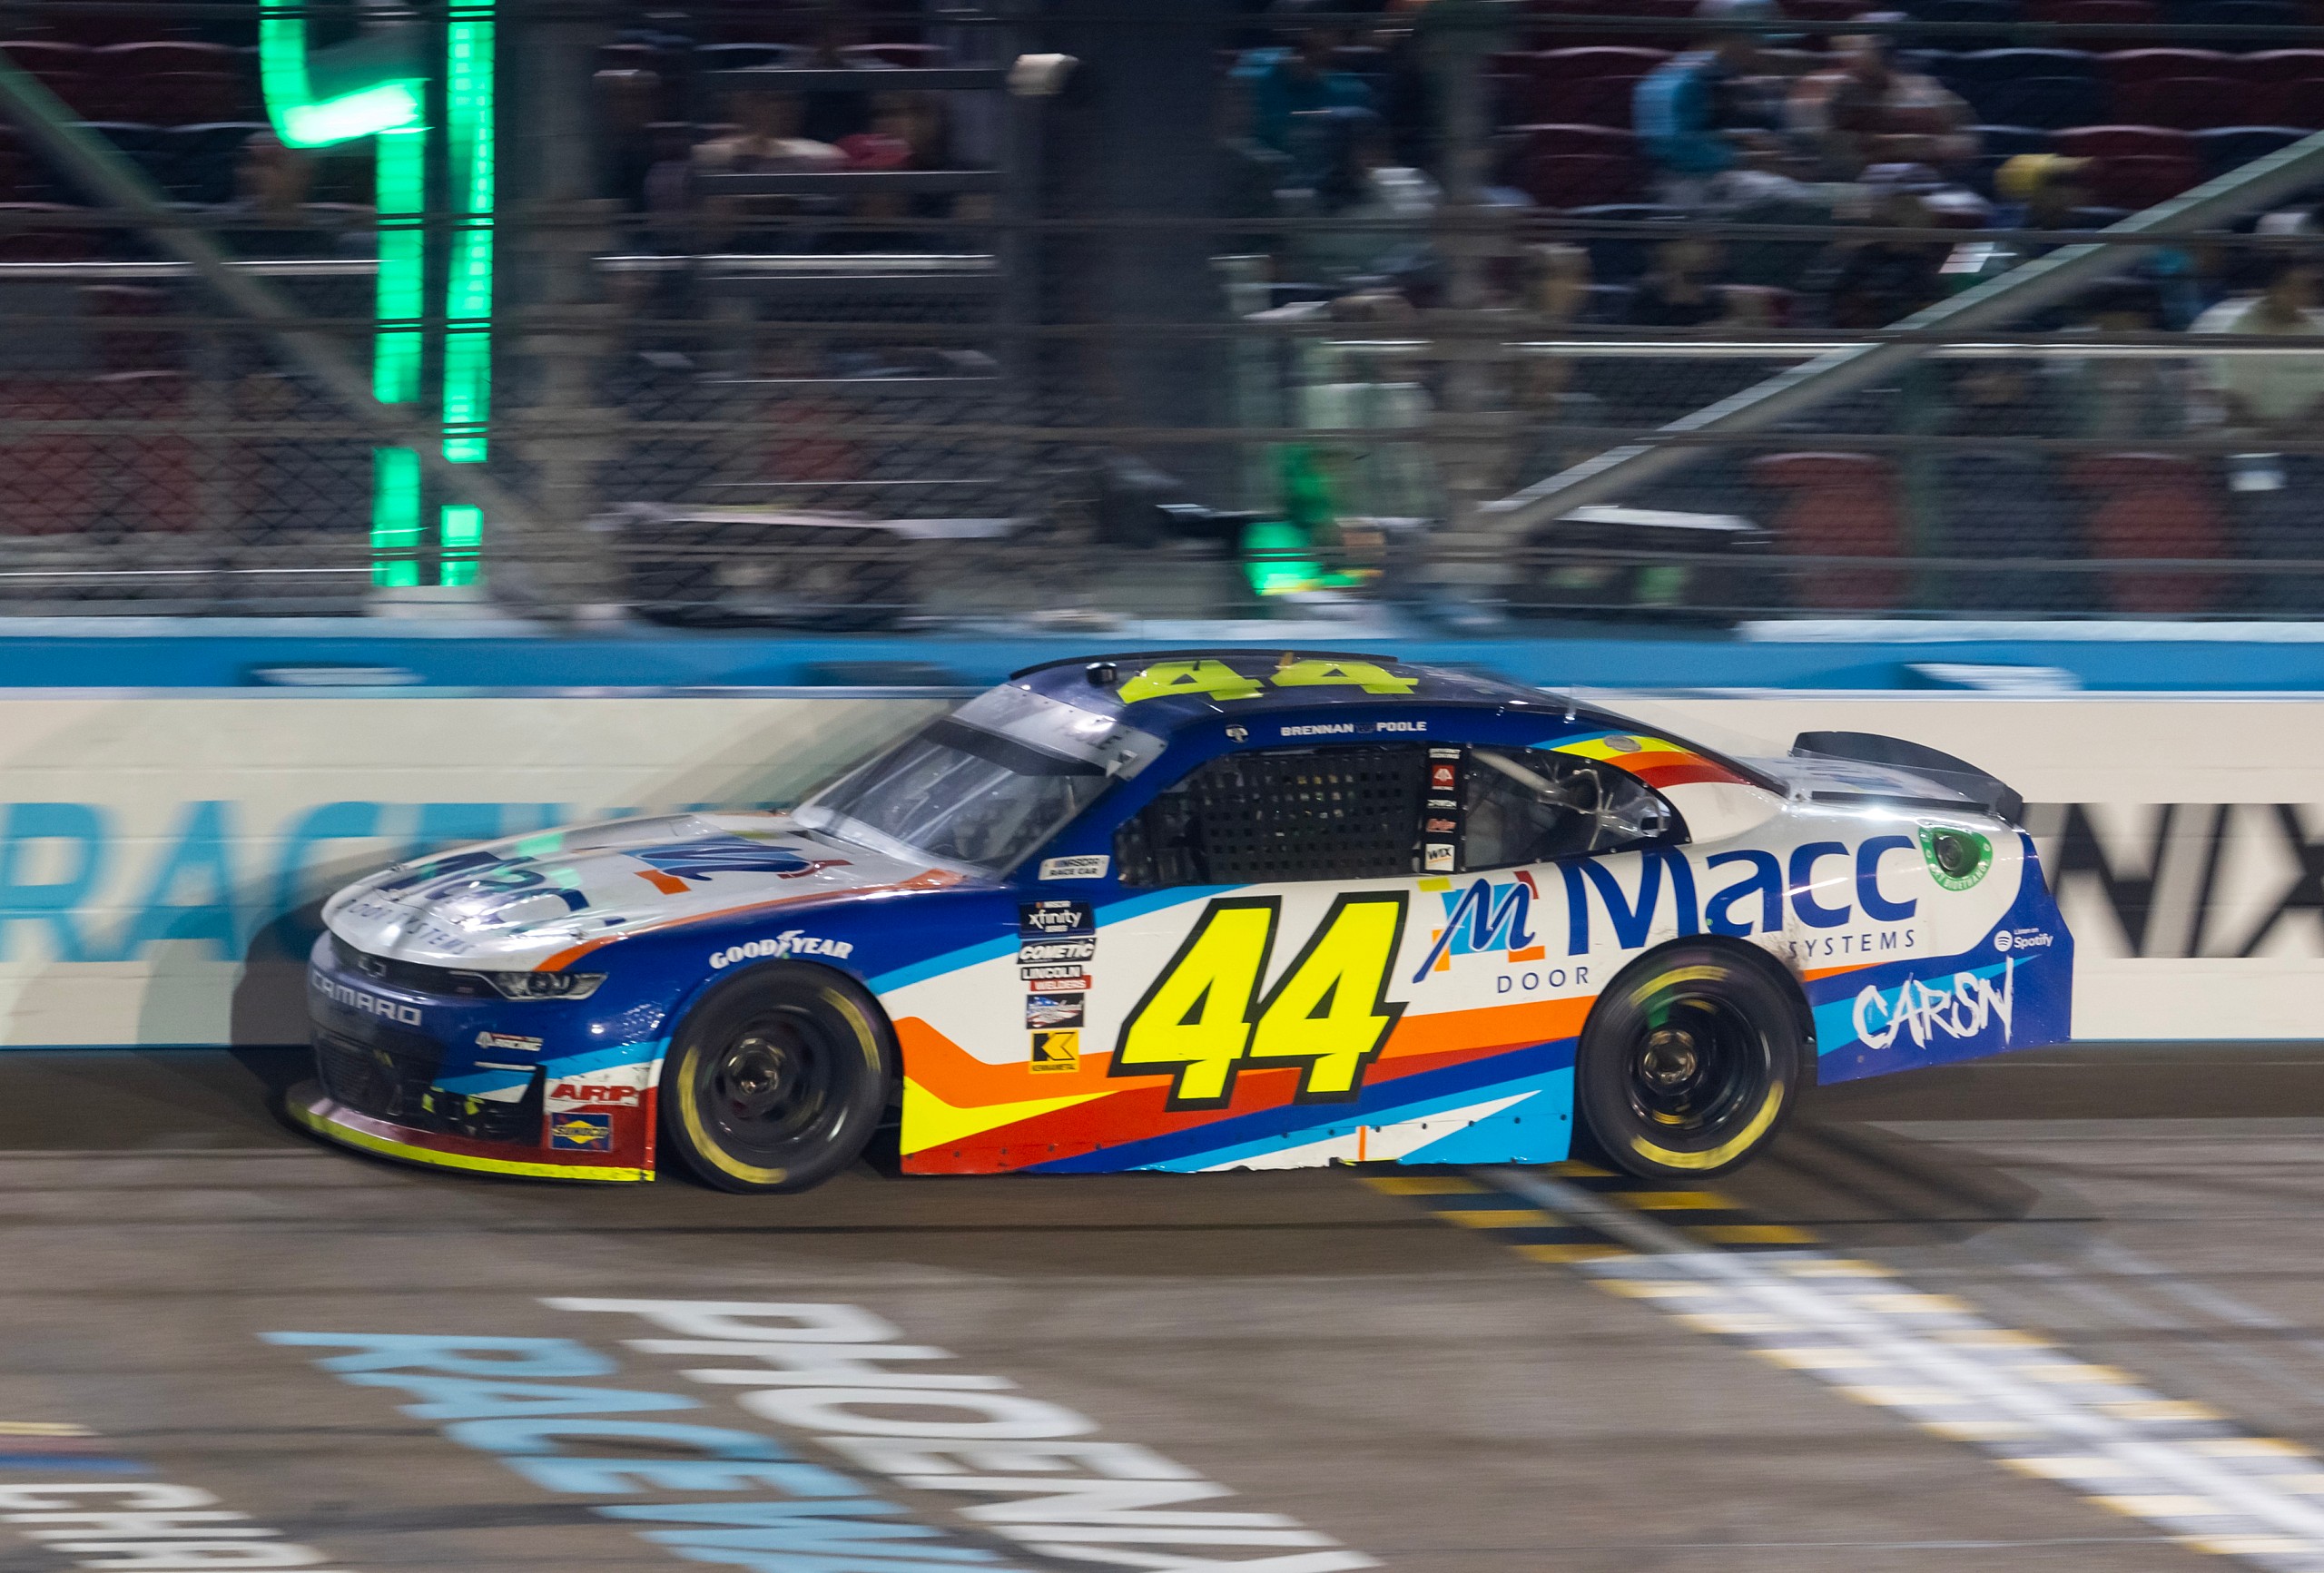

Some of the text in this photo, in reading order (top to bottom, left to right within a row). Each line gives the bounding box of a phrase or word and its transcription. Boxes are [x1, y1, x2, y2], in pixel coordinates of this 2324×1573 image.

[1280, 722, 1427, 736] BRENNAN POOLE
[1553, 835, 1918, 957] Macc
[1029, 909, 1082, 929] xfinity
[708, 929, 854, 969] GOODYEAR
[1019, 943, 1095, 959] COMETIC
[1788, 929, 1915, 959] SYSTEMS
[2014, 933, 2053, 949] Spotify
[1022, 967, 1081, 978] LINCOLN
[1497, 967, 1589, 994] DOOR
[312, 968, 421, 1027] CAMARO
[1107, 890, 1409, 1112] 44
[550, 1084, 636, 1101] ARP
